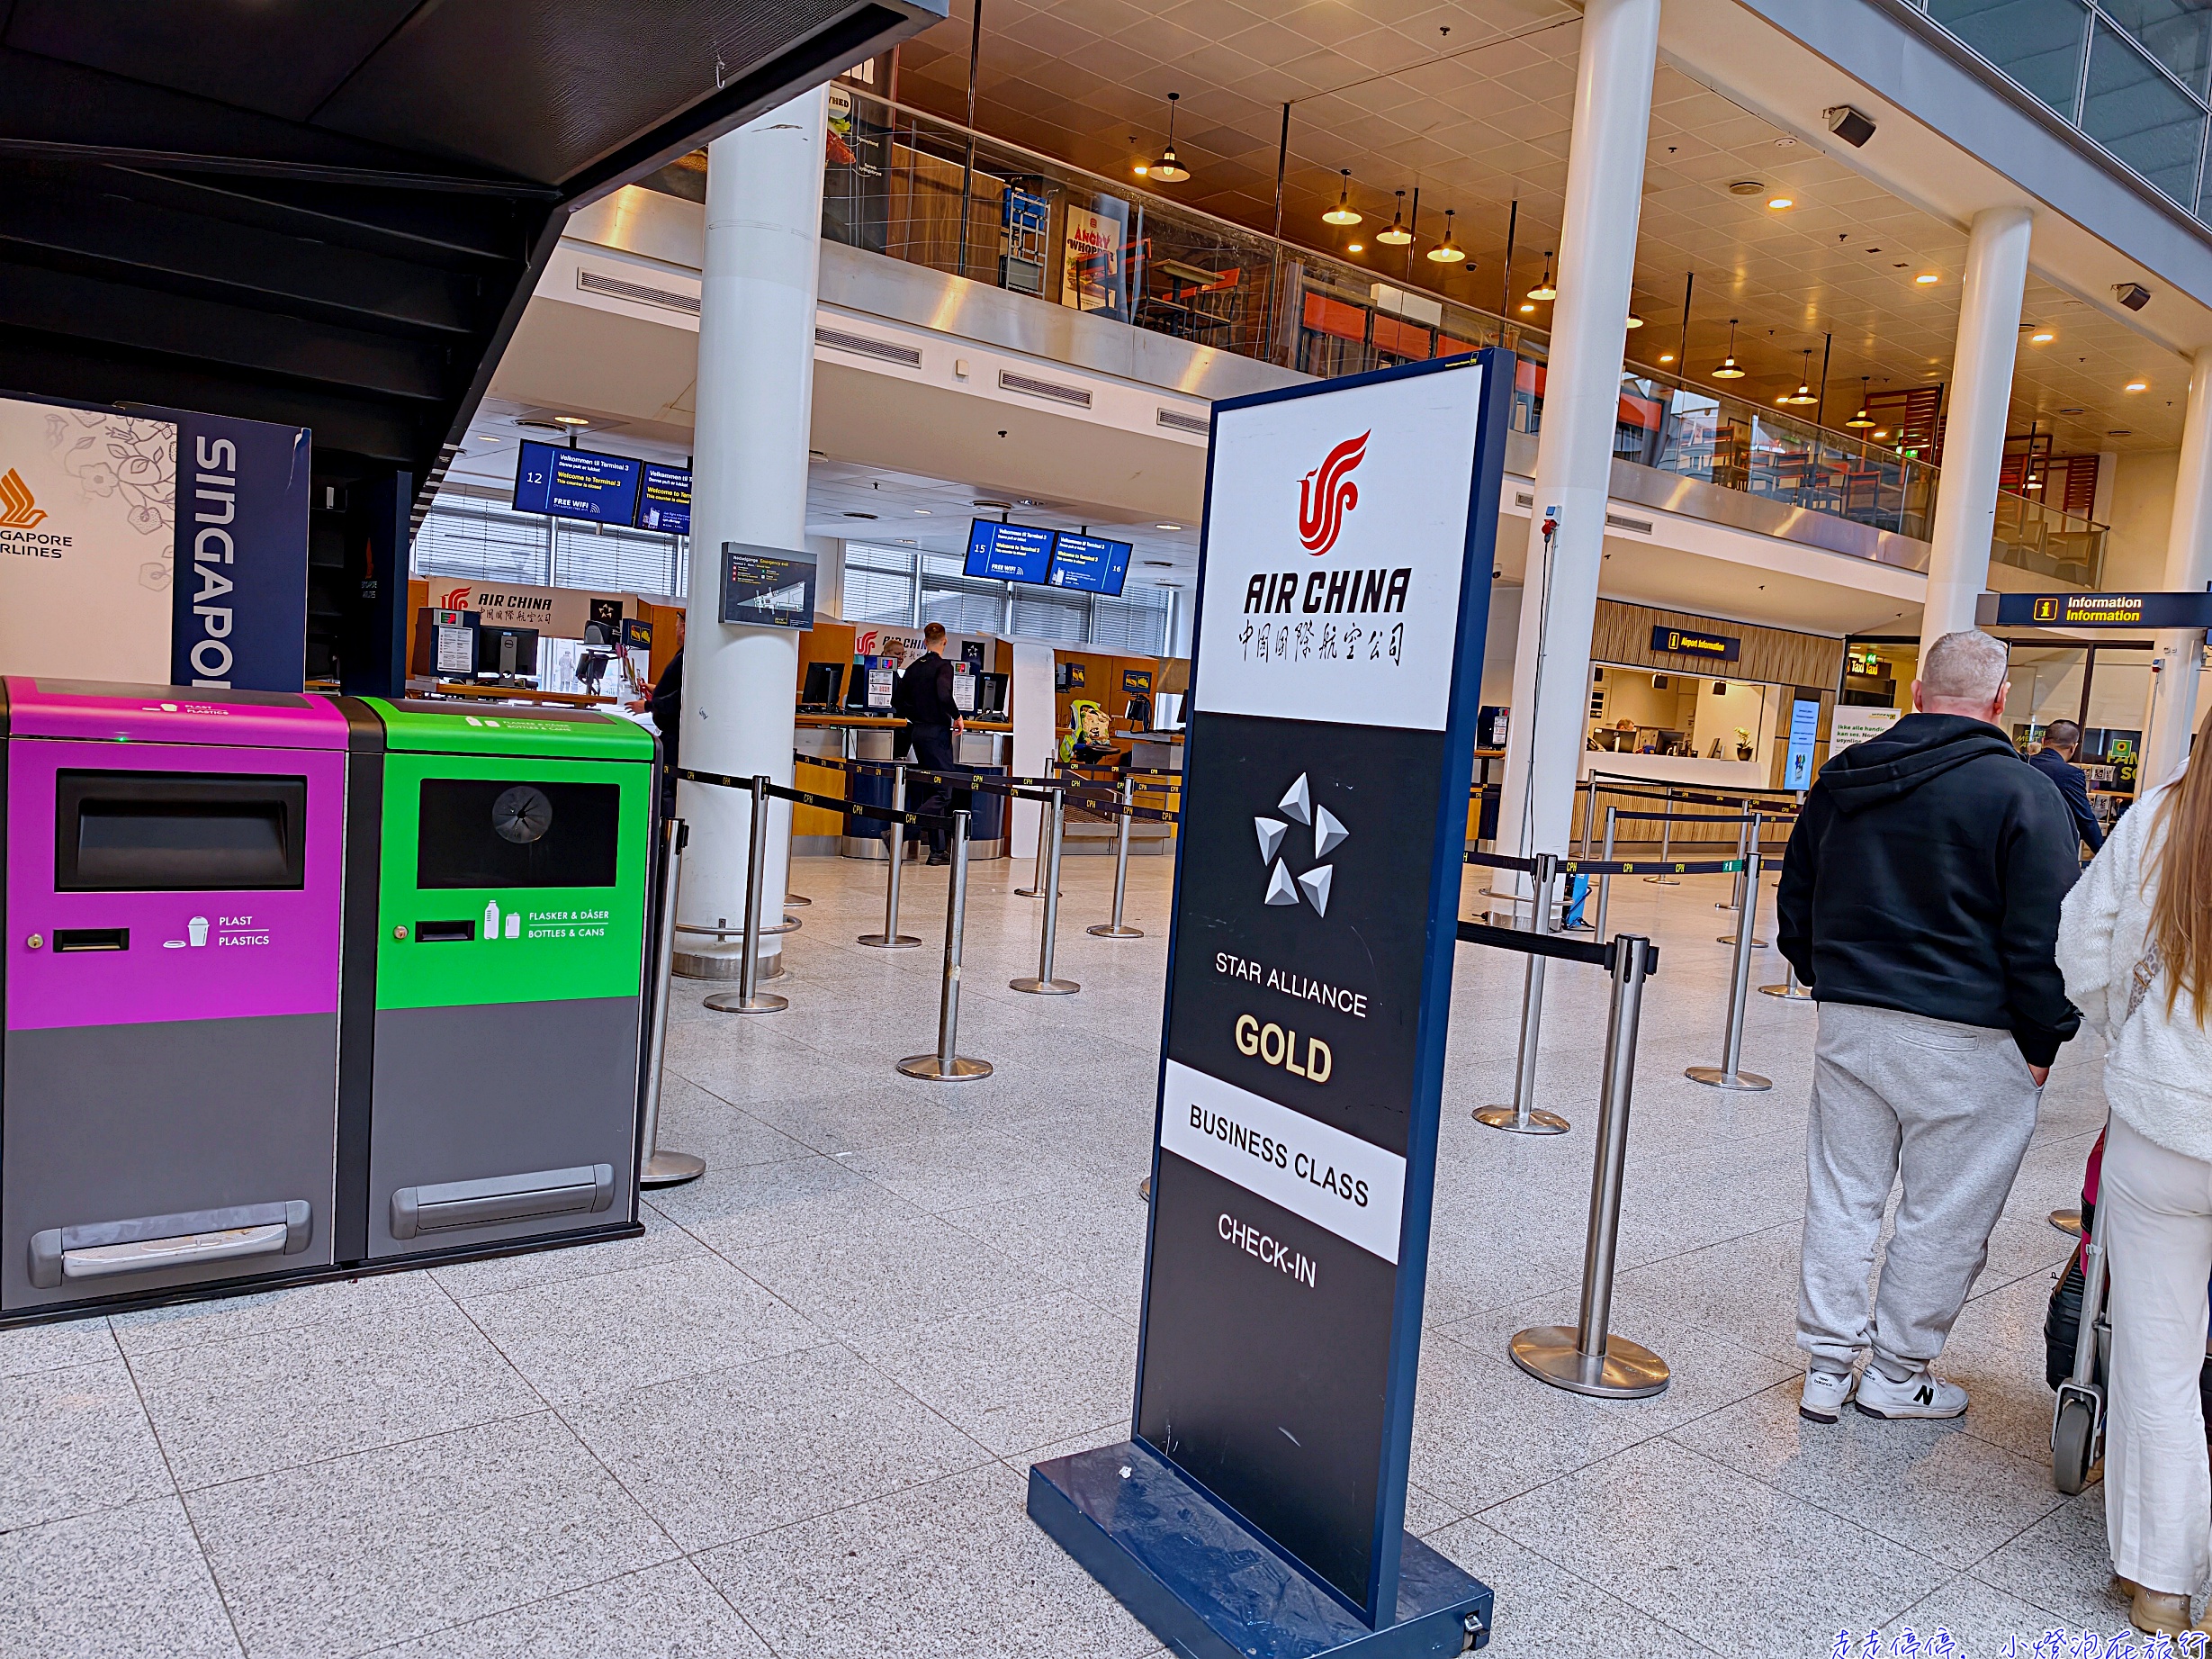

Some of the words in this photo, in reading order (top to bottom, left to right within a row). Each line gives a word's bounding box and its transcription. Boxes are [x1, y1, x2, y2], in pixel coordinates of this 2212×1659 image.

[1075, 224, 1111, 249] ANGRY
[1067, 239, 1115, 262] WHOPR
[560, 454, 593, 465] Velkommen
[601, 461, 624, 470] Terminal
[526, 472, 543, 484] 12
[558, 471, 584, 481] Welcome
[592, 477, 616, 485] Terminal
[650, 470, 681, 481] Velkommen
[647, 486, 672, 495] Welcome
[553, 498, 571, 506] FREE
[572, 500, 589, 509] WIFI
[0, 530, 72, 546] GAPORE
[0, 544, 62, 559] RLINES
[974, 544, 985, 554] 15
[190, 436, 237, 690] SINGAPO
[1244, 573, 1299, 614] AIR
[1302, 567, 1412, 614] CHINA
[478, 593, 505, 607] AIR
[507, 596, 553, 610] CHINA
[2068, 597, 2142, 609] Information
[2066, 609, 2141, 621] Information
[904, 638, 926, 650] CHIN
[1680, 637, 1698, 648] Airport
[1698, 639, 1725, 652] Information
[1852, 660, 1865, 673] Taxi
[1866, 663, 1878, 675] Taxi
[723, 777, 731, 786] CPH
[973, 775, 984, 783] CPH
[1071, 780, 1081, 788] CPH
[804, 794, 814, 804] CPH
[852, 805, 863, 816] CPH
[905, 814, 917, 824] CPH
[1086, 799, 1096, 808] CPH
[1123, 806, 1133, 815] CPH
[1162, 812, 1173, 821] CPH
[1566, 861, 1578, 872] CPH
[1623, 862, 1633, 873] CPH
[1675, 862, 1686, 873] CPH
[219, 916, 253, 926] PLAST
[529, 912, 568, 921] FLASKER
[571, 911, 578, 920] &
[580, 908, 609, 919] DÅSER
[528, 929, 566, 938] BOTTLES
[569, 929, 575, 937] &
[578, 928, 605, 937] CANS
[219, 935, 269, 946] PLASTICS
[1215, 951, 1262, 985] STAR
[1267, 968, 1368, 1018] ALLIANCE
[1235, 1013, 1332, 1083] GOLD
[1190, 1103, 1288, 1169] BUSINESS
[1294, 1153, 1369, 1208] CLASS
[1218, 1213, 1317, 1288] CHECK-IN
[1814, 1379, 1832, 1387] balance
